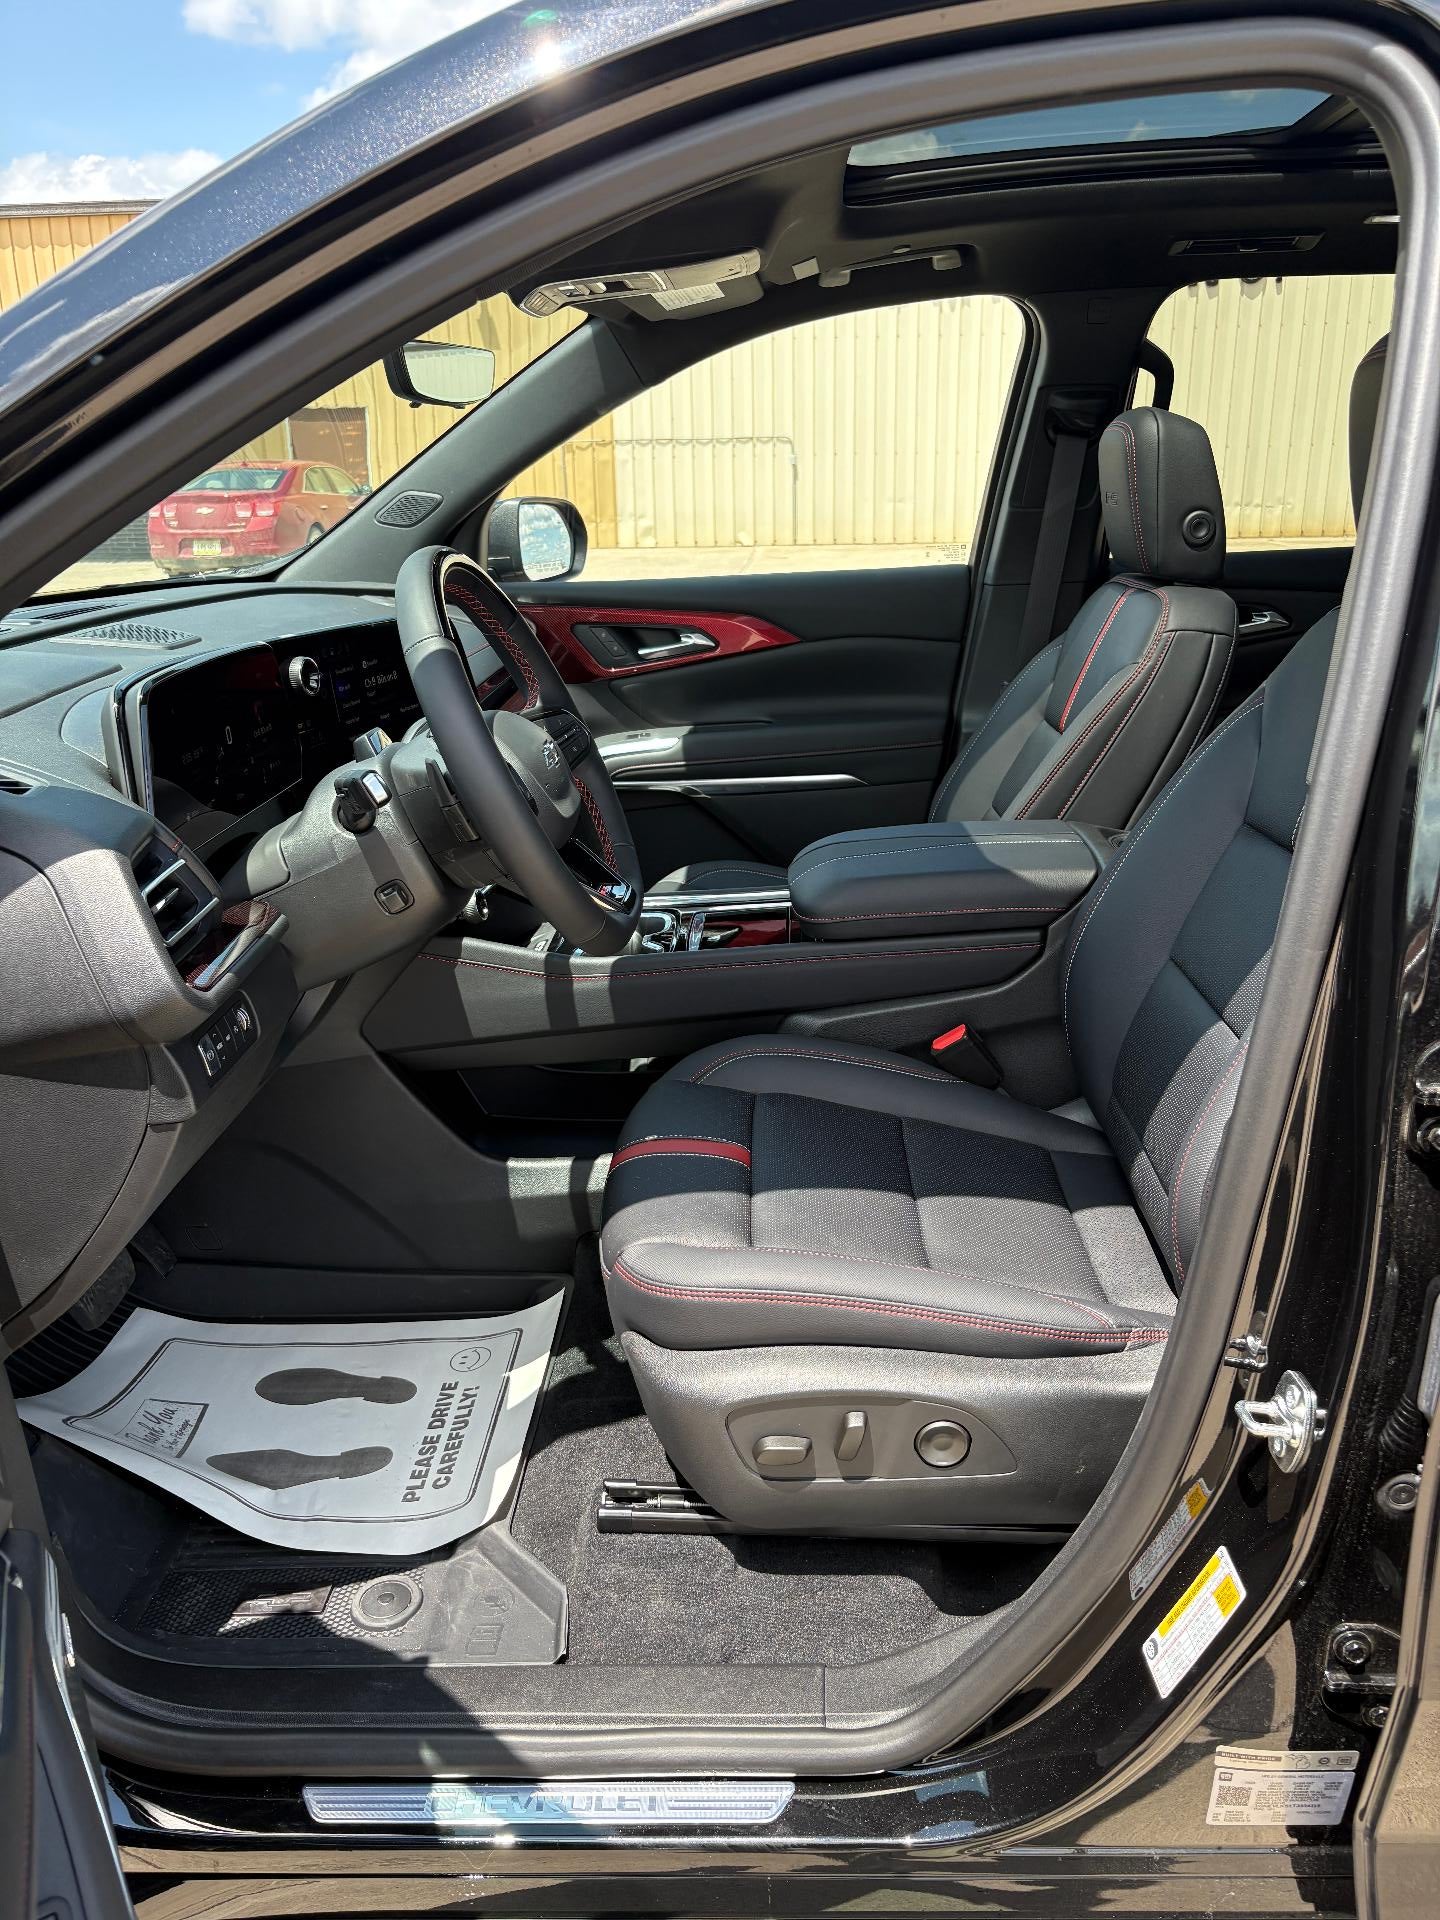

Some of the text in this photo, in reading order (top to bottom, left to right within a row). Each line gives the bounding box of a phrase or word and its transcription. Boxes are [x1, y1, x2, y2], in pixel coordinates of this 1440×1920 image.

[401, 1380, 460, 1503] PLEASE DRIVE
[431, 1385, 480, 1490] CAREFULLY!
[428, 1791, 666, 1813] CHEVROLET
